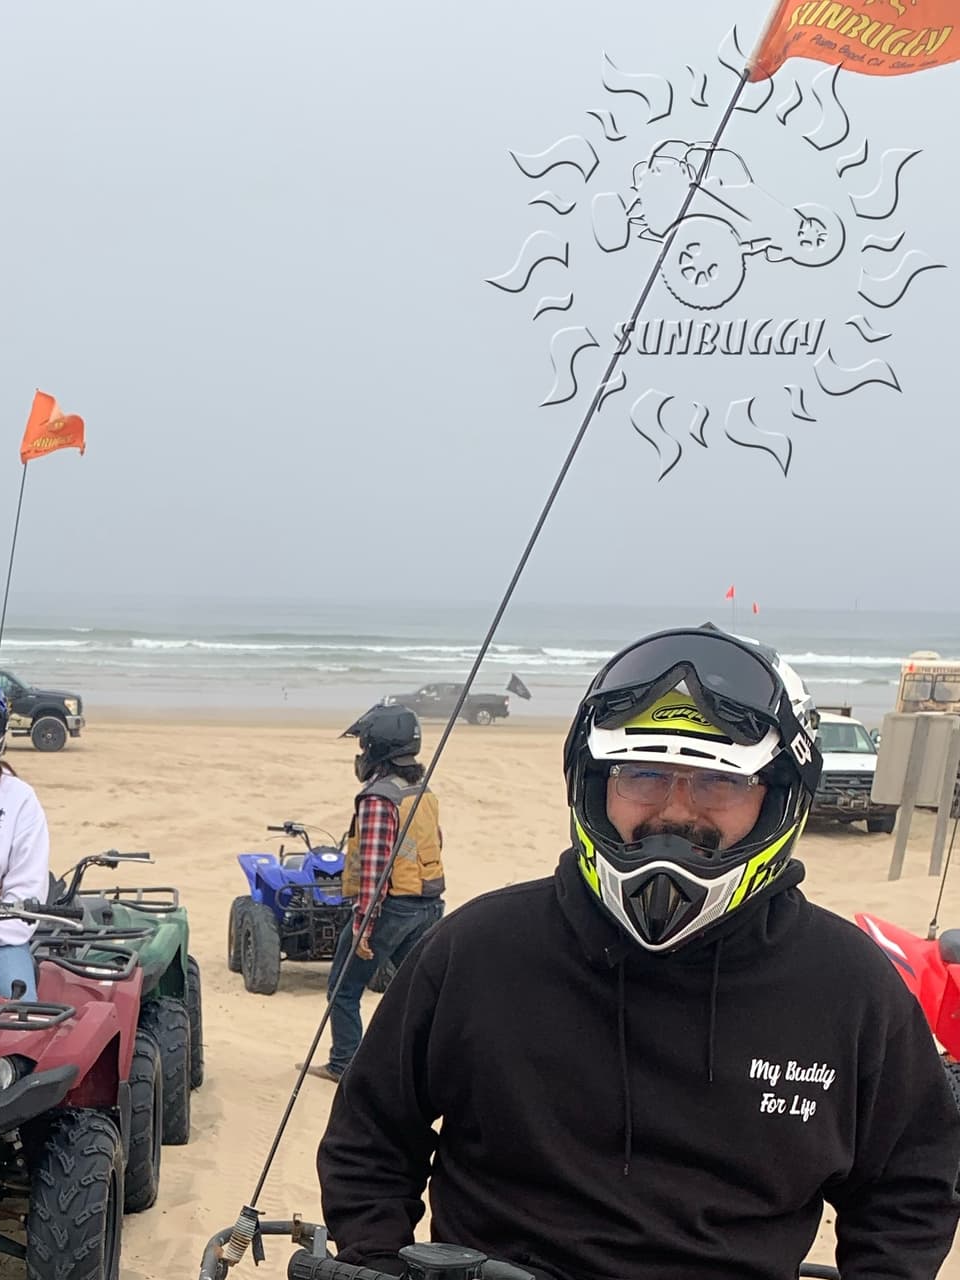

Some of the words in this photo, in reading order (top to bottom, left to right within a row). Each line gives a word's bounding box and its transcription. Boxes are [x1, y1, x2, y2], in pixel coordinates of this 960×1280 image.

[786, 0, 954, 58] SUNBUGGY
[749, 1058, 782, 1087] My
[785, 1060, 837, 1091] Buddy
[760, 1092, 787, 1114] For
[789, 1094, 817, 1123] Life
